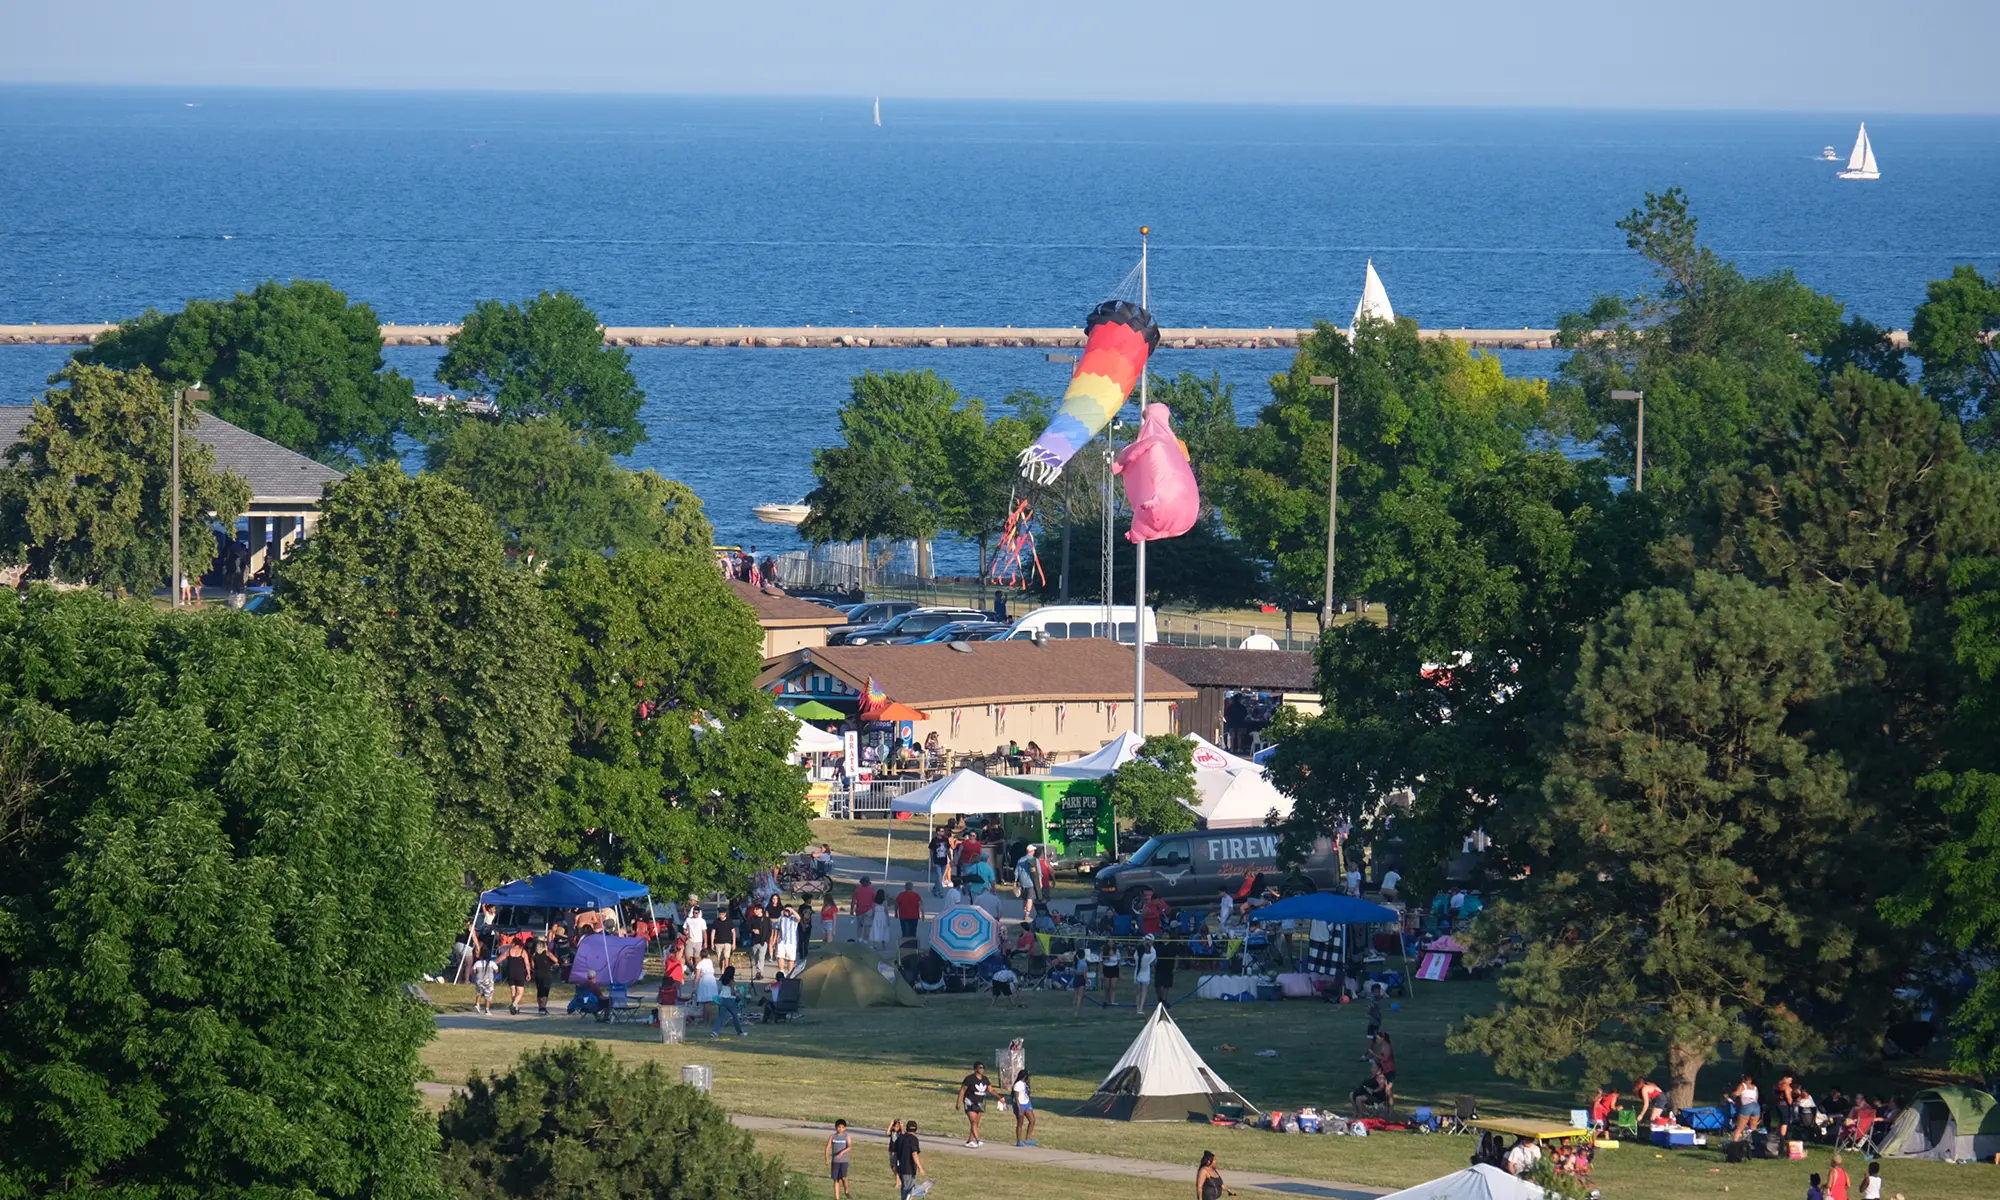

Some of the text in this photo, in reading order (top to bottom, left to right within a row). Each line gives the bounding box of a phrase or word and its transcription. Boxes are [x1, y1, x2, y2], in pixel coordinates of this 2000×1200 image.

[1061, 796, 1097, 810] PARK PUB
[1208, 836, 1280, 860] FIREW
